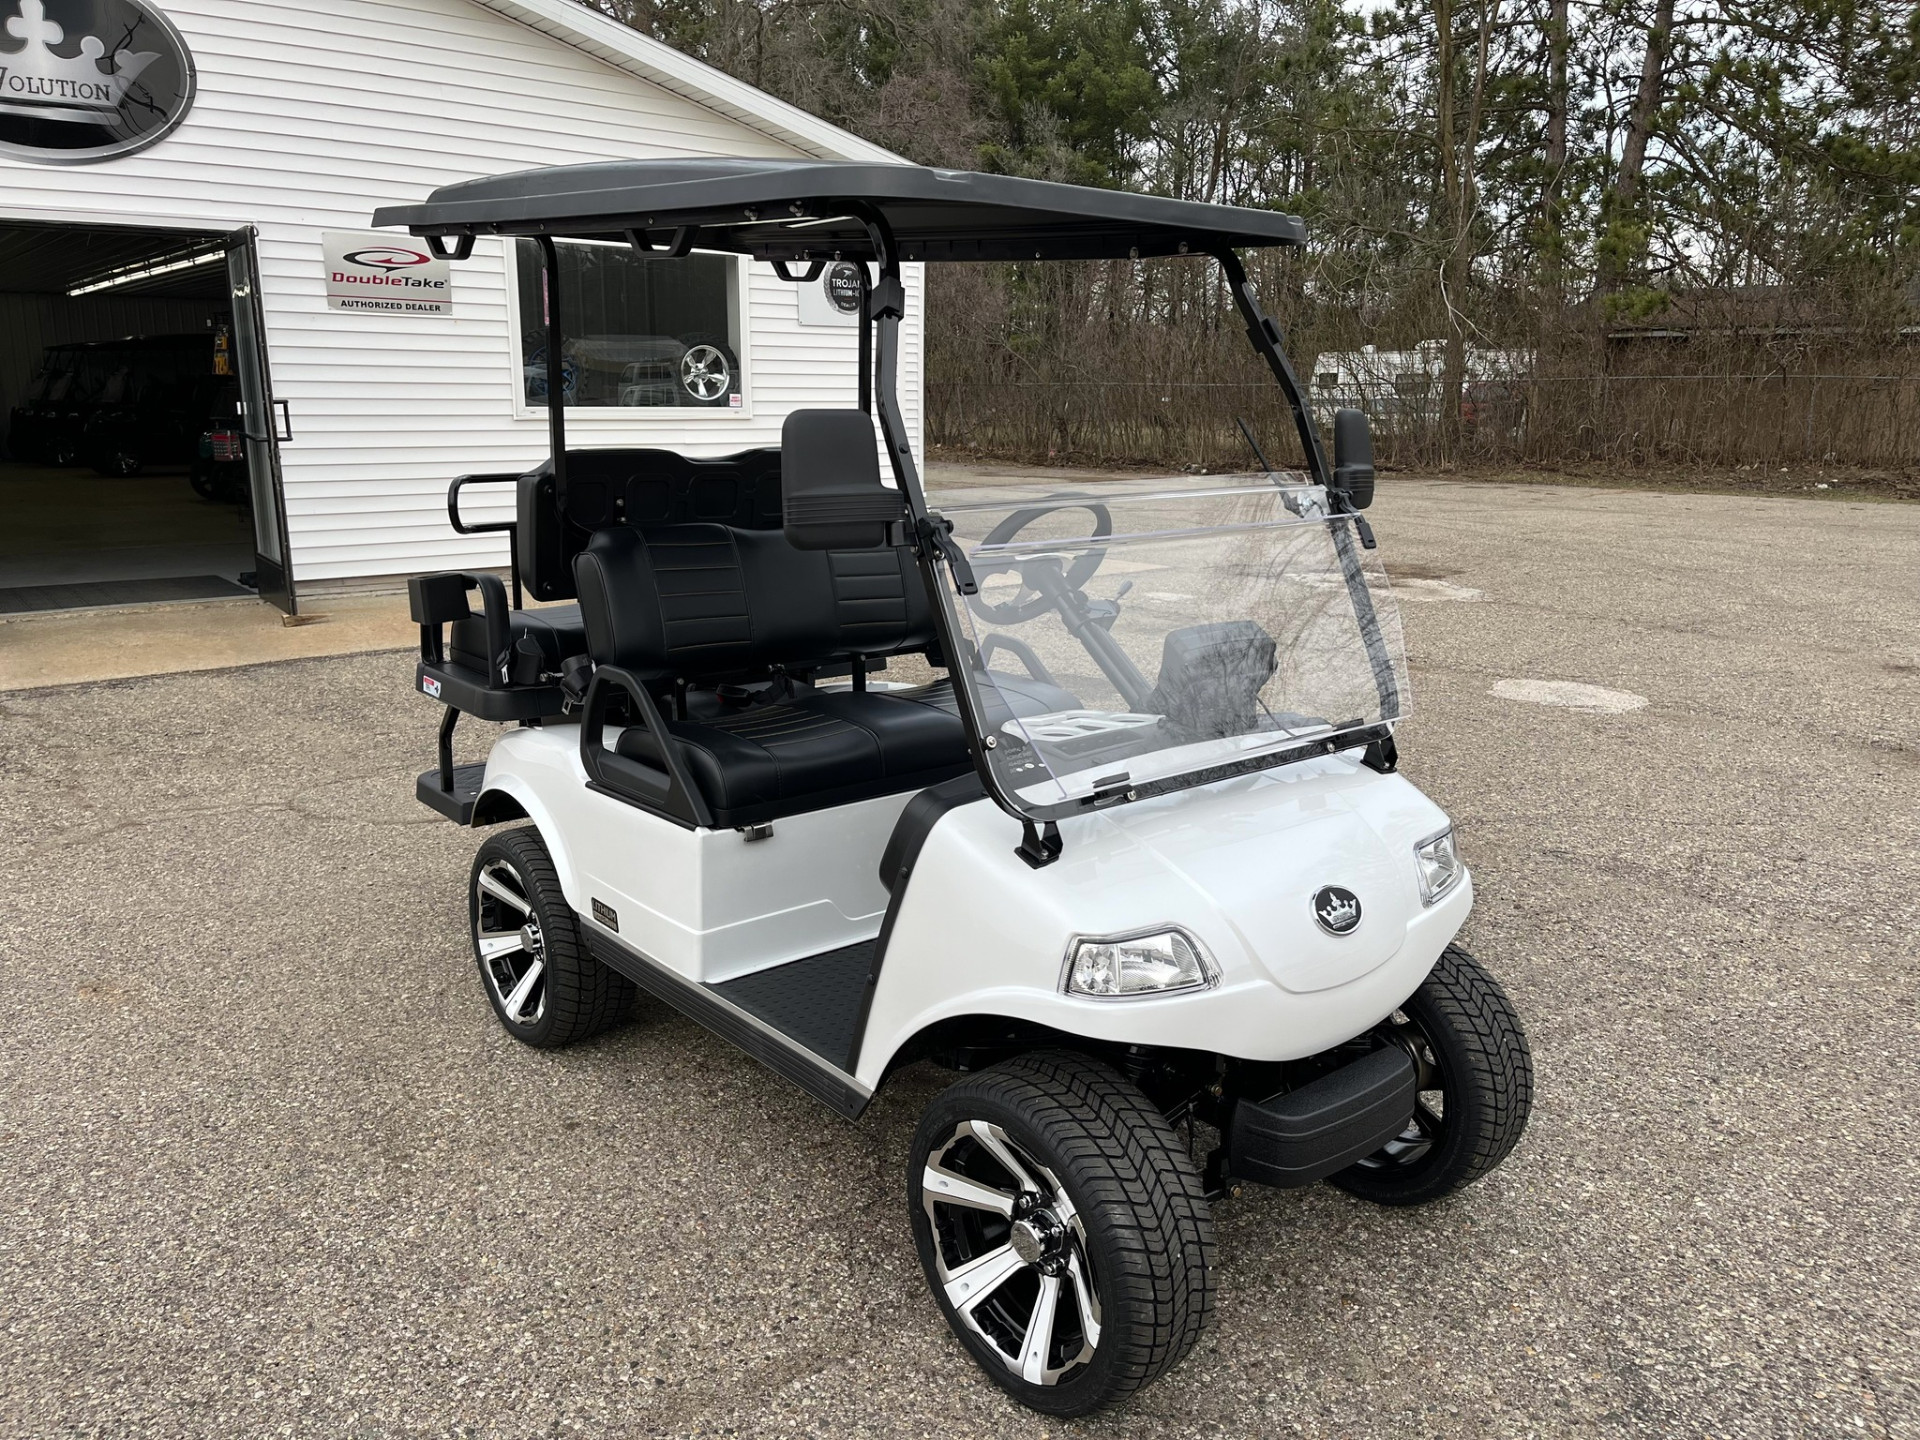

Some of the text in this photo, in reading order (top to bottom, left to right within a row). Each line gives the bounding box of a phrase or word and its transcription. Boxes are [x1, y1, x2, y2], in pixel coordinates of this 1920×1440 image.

[331, 272, 445, 289] DoubleTake
[831, 278, 860, 289] TROJA
[340, 300, 441, 312] AUTHORIZED DEALER
